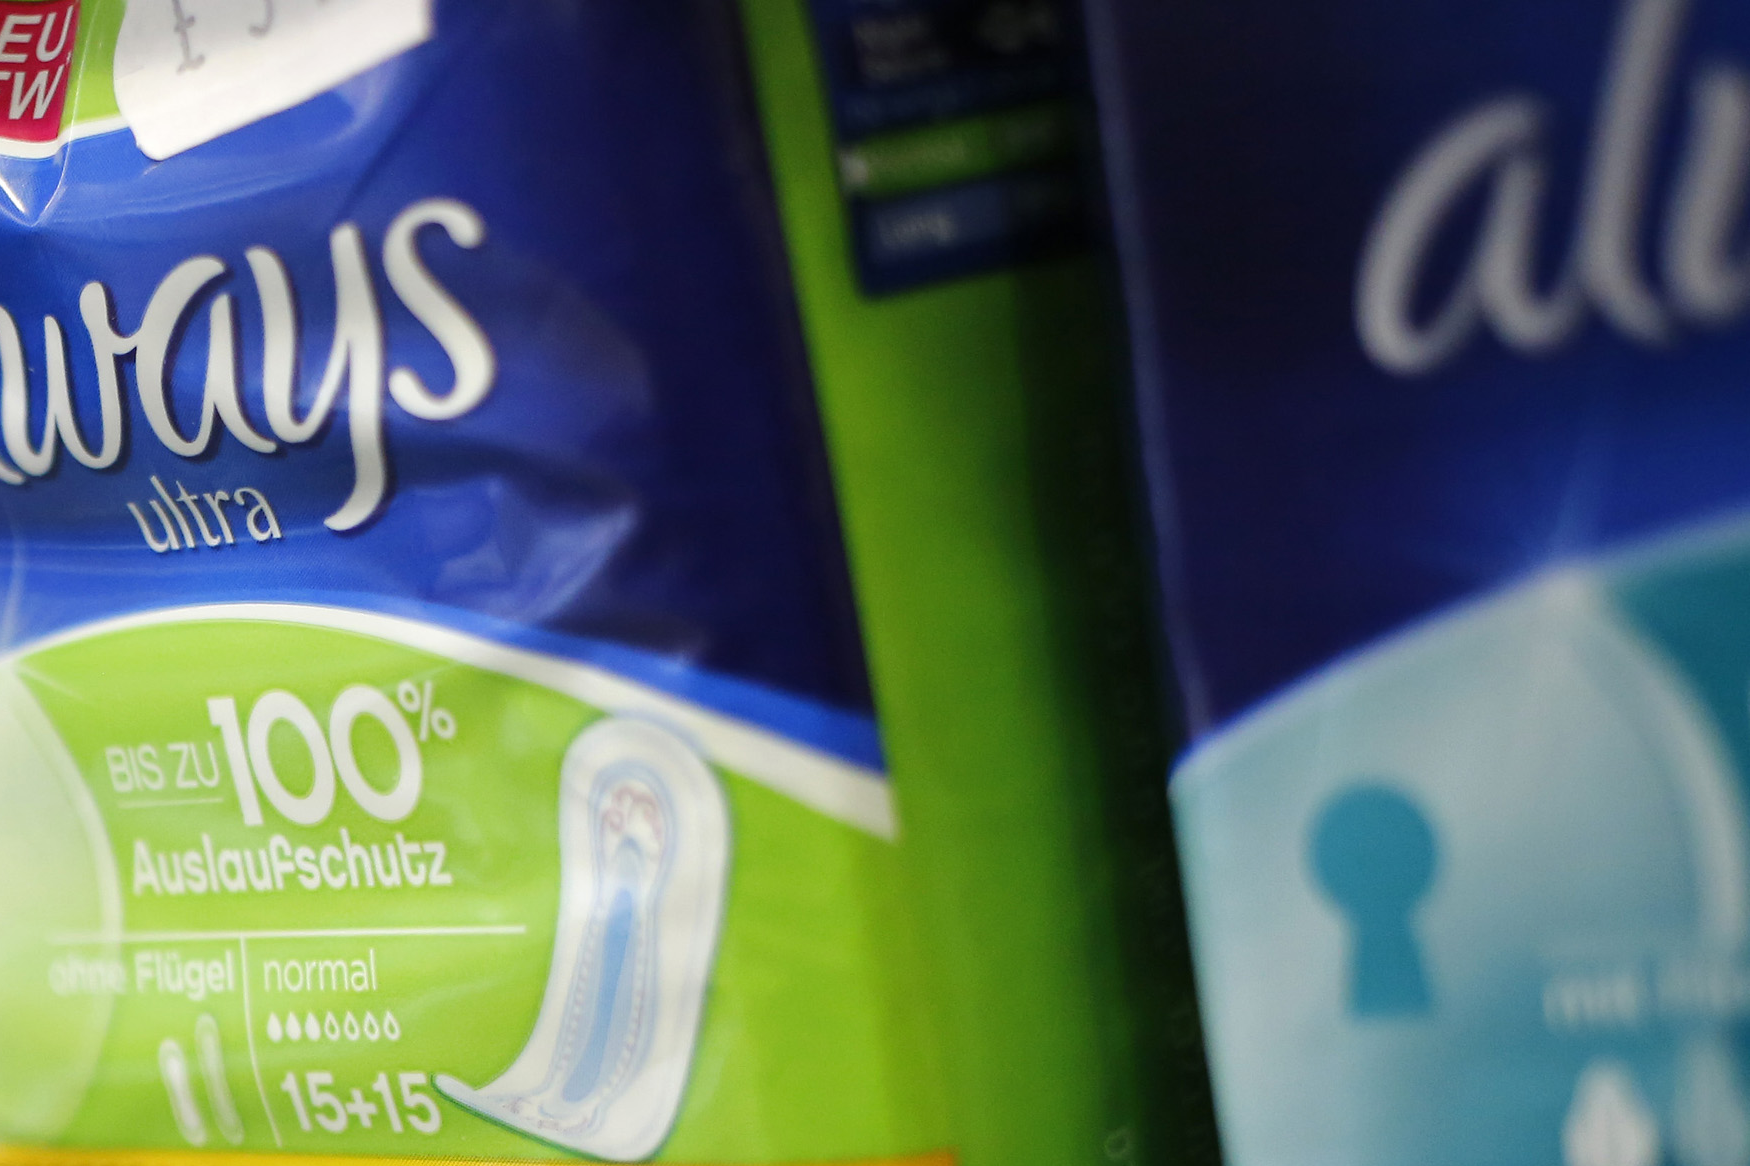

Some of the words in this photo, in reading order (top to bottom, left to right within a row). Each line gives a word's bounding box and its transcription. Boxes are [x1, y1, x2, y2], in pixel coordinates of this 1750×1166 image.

[126, 474, 283, 553] ultra
[105, 742, 164, 794] BIS
[170, 738, 221, 791] ZU
[130, 826, 454, 896] Auslaufschutz
[134, 948, 237, 1002] Flügel
[262, 947, 380, 994] normal
[280, 1069, 443, 1136] 15+15
